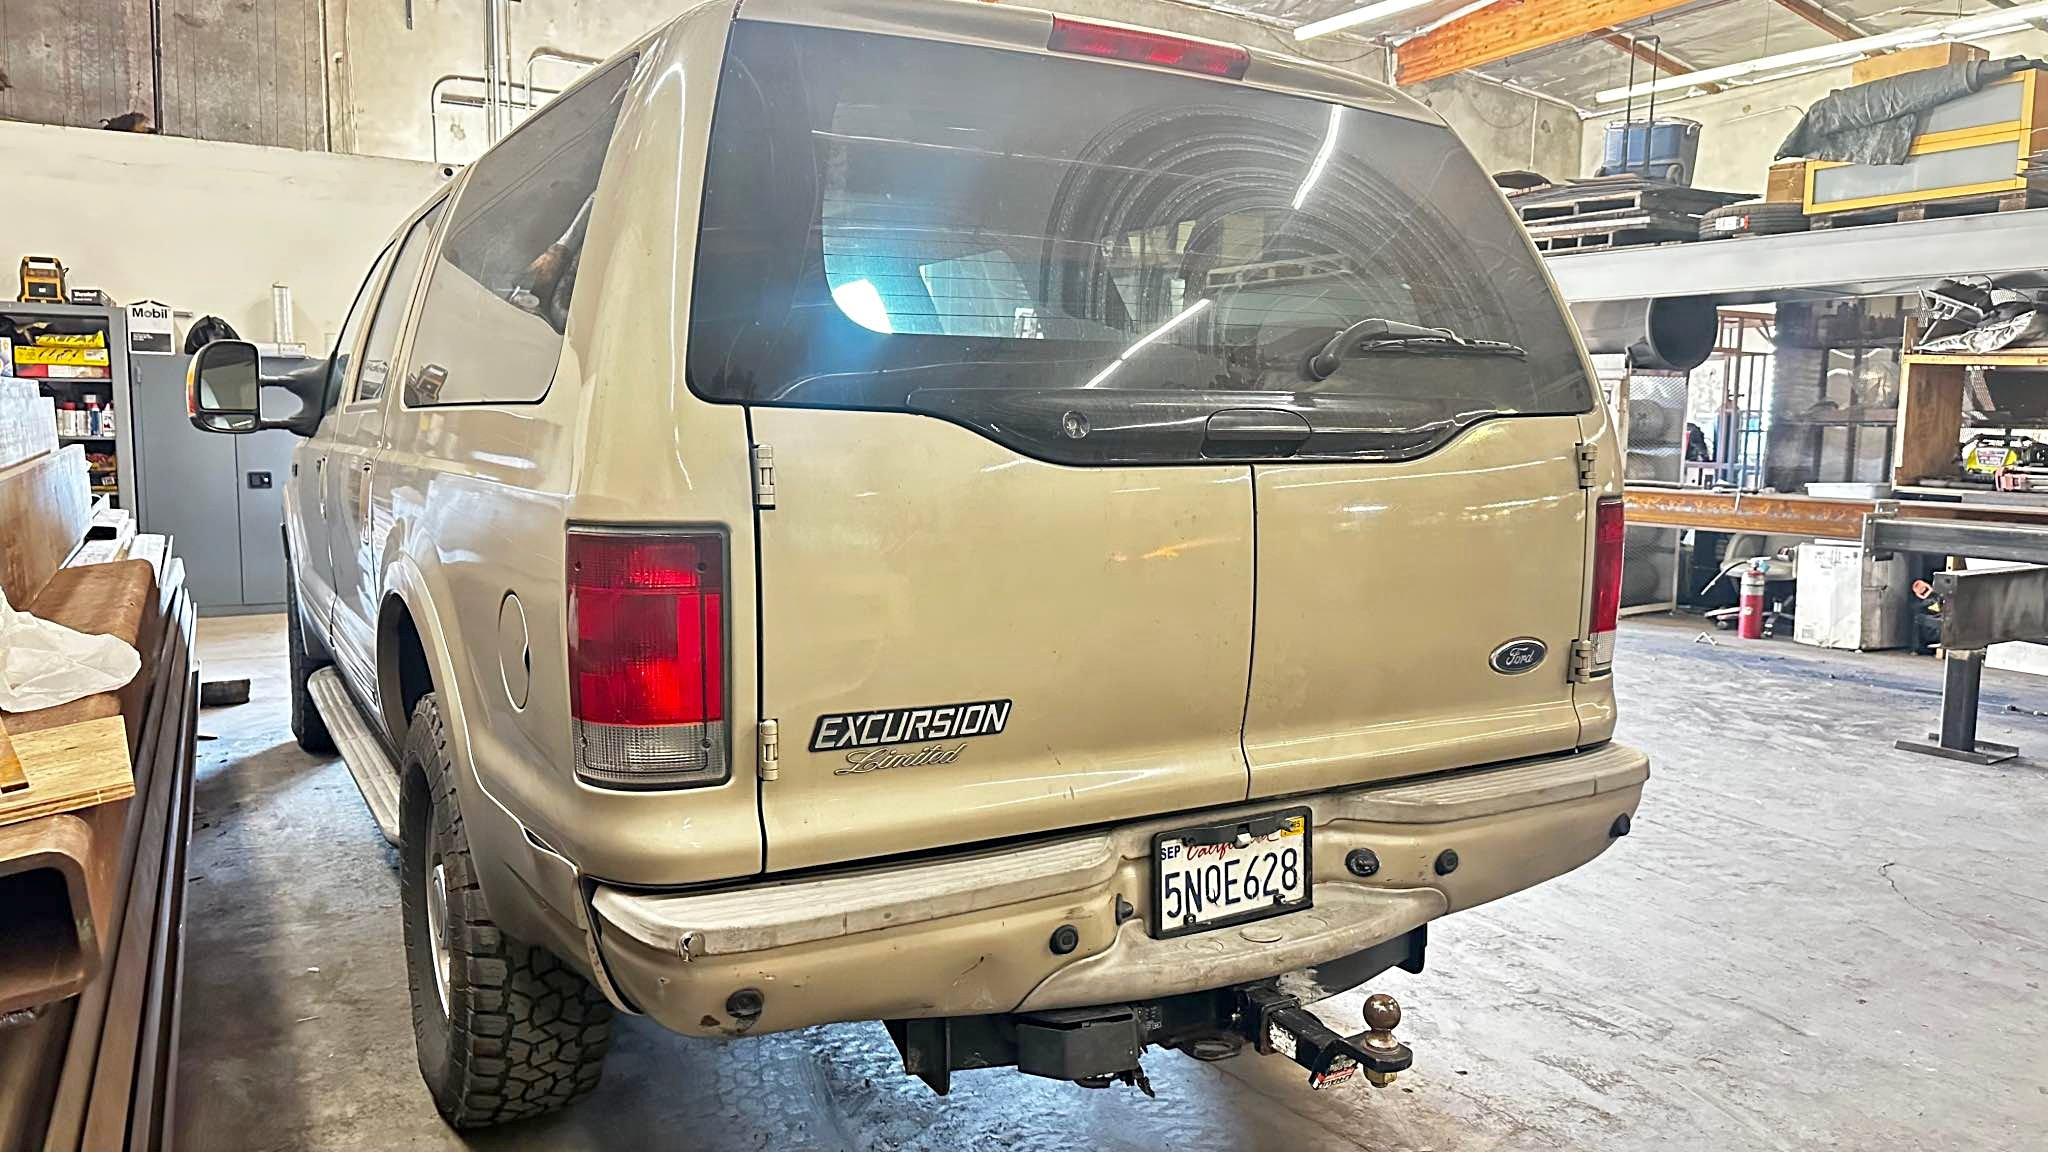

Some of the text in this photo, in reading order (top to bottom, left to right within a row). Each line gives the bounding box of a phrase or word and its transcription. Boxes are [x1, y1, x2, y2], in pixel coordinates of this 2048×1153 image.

[132, 307, 168, 319] Mobil
[1505, 646, 1535, 666] Ford
[814, 702, 1010, 749] EXCURSION
[833, 743, 968, 776] Limited
[1160, 845, 1181, 861] SEP
[1186, 834, 1280, 861] Califia
[1164, 847, 1298, 918] 5NQE628
